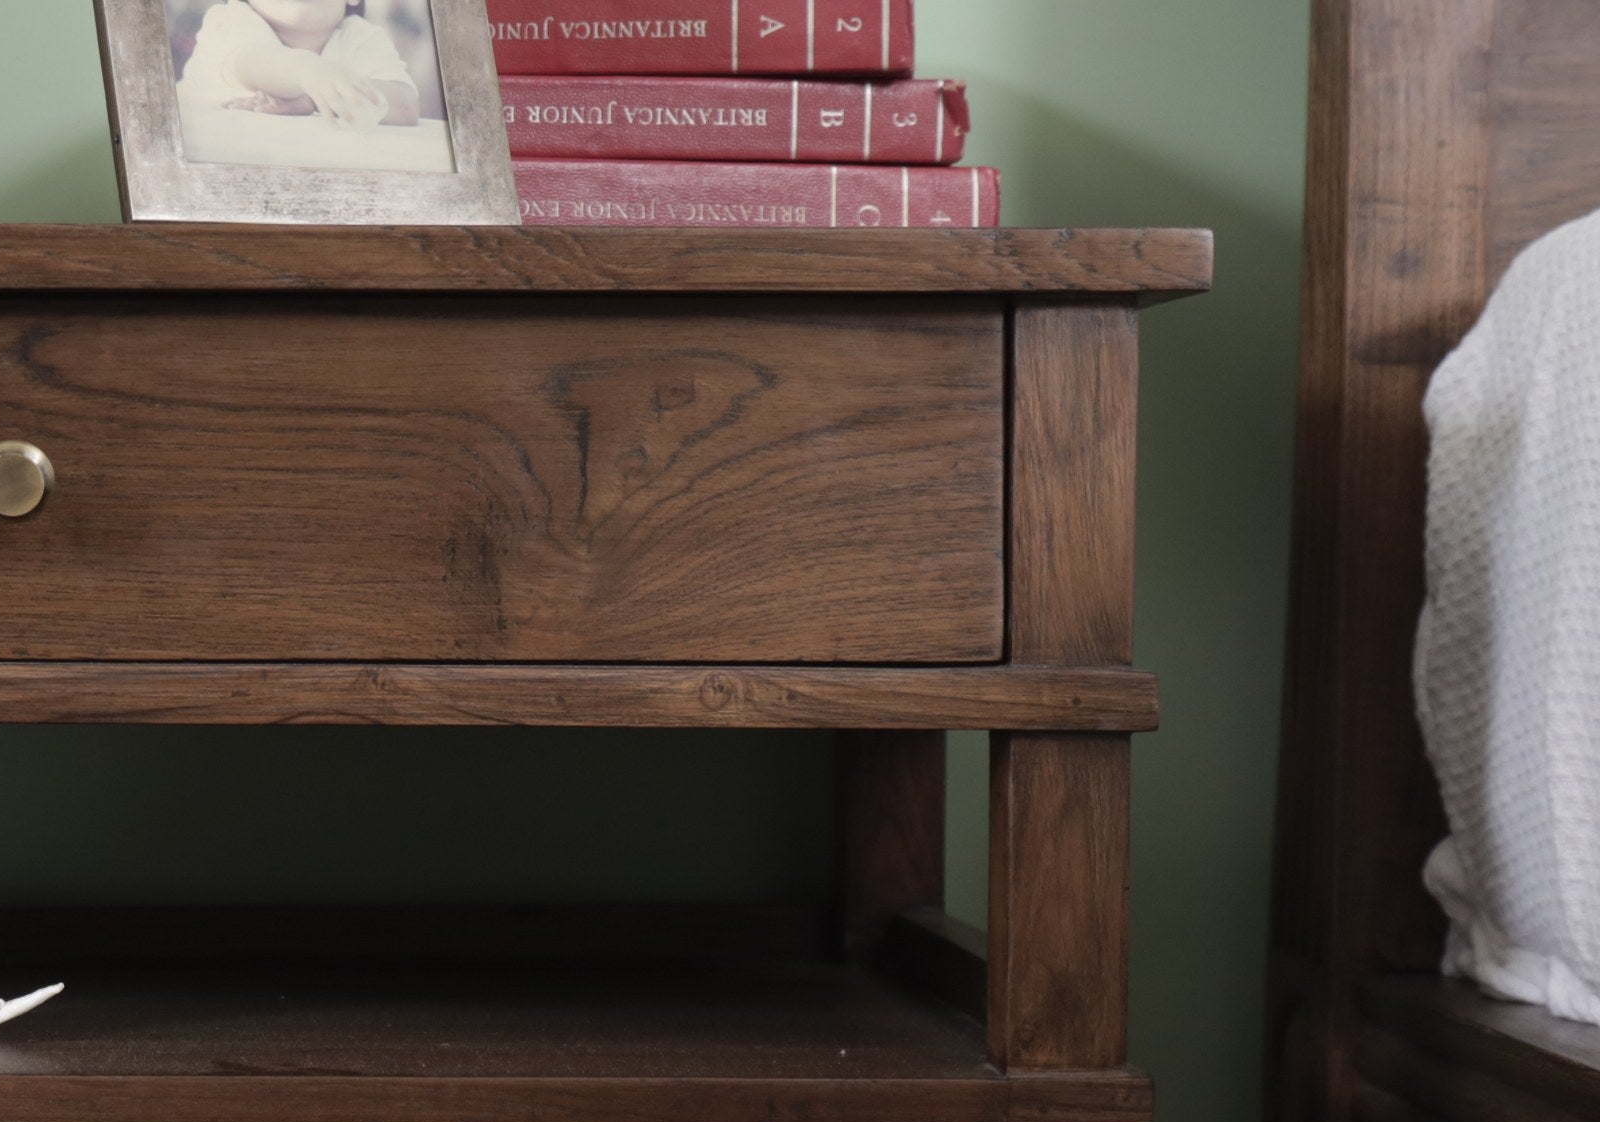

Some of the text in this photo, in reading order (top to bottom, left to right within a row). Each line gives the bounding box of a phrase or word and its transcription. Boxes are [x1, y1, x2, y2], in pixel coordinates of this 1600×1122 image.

[559, 20, 707, 41] BRITANNICA
[759, 15, 785, 38] A
[836, 17, 862, 33] 2
[526, 101, 618, 125] JUNIOR
[623, 106, 768, 127] BRITANNICA
[819, 108, 845, 128] B
[892, 112, 918, 128] 3
[572, 199, 658, 221] JUNIOR
[666, 203, 807, 224] BRITANNICA
